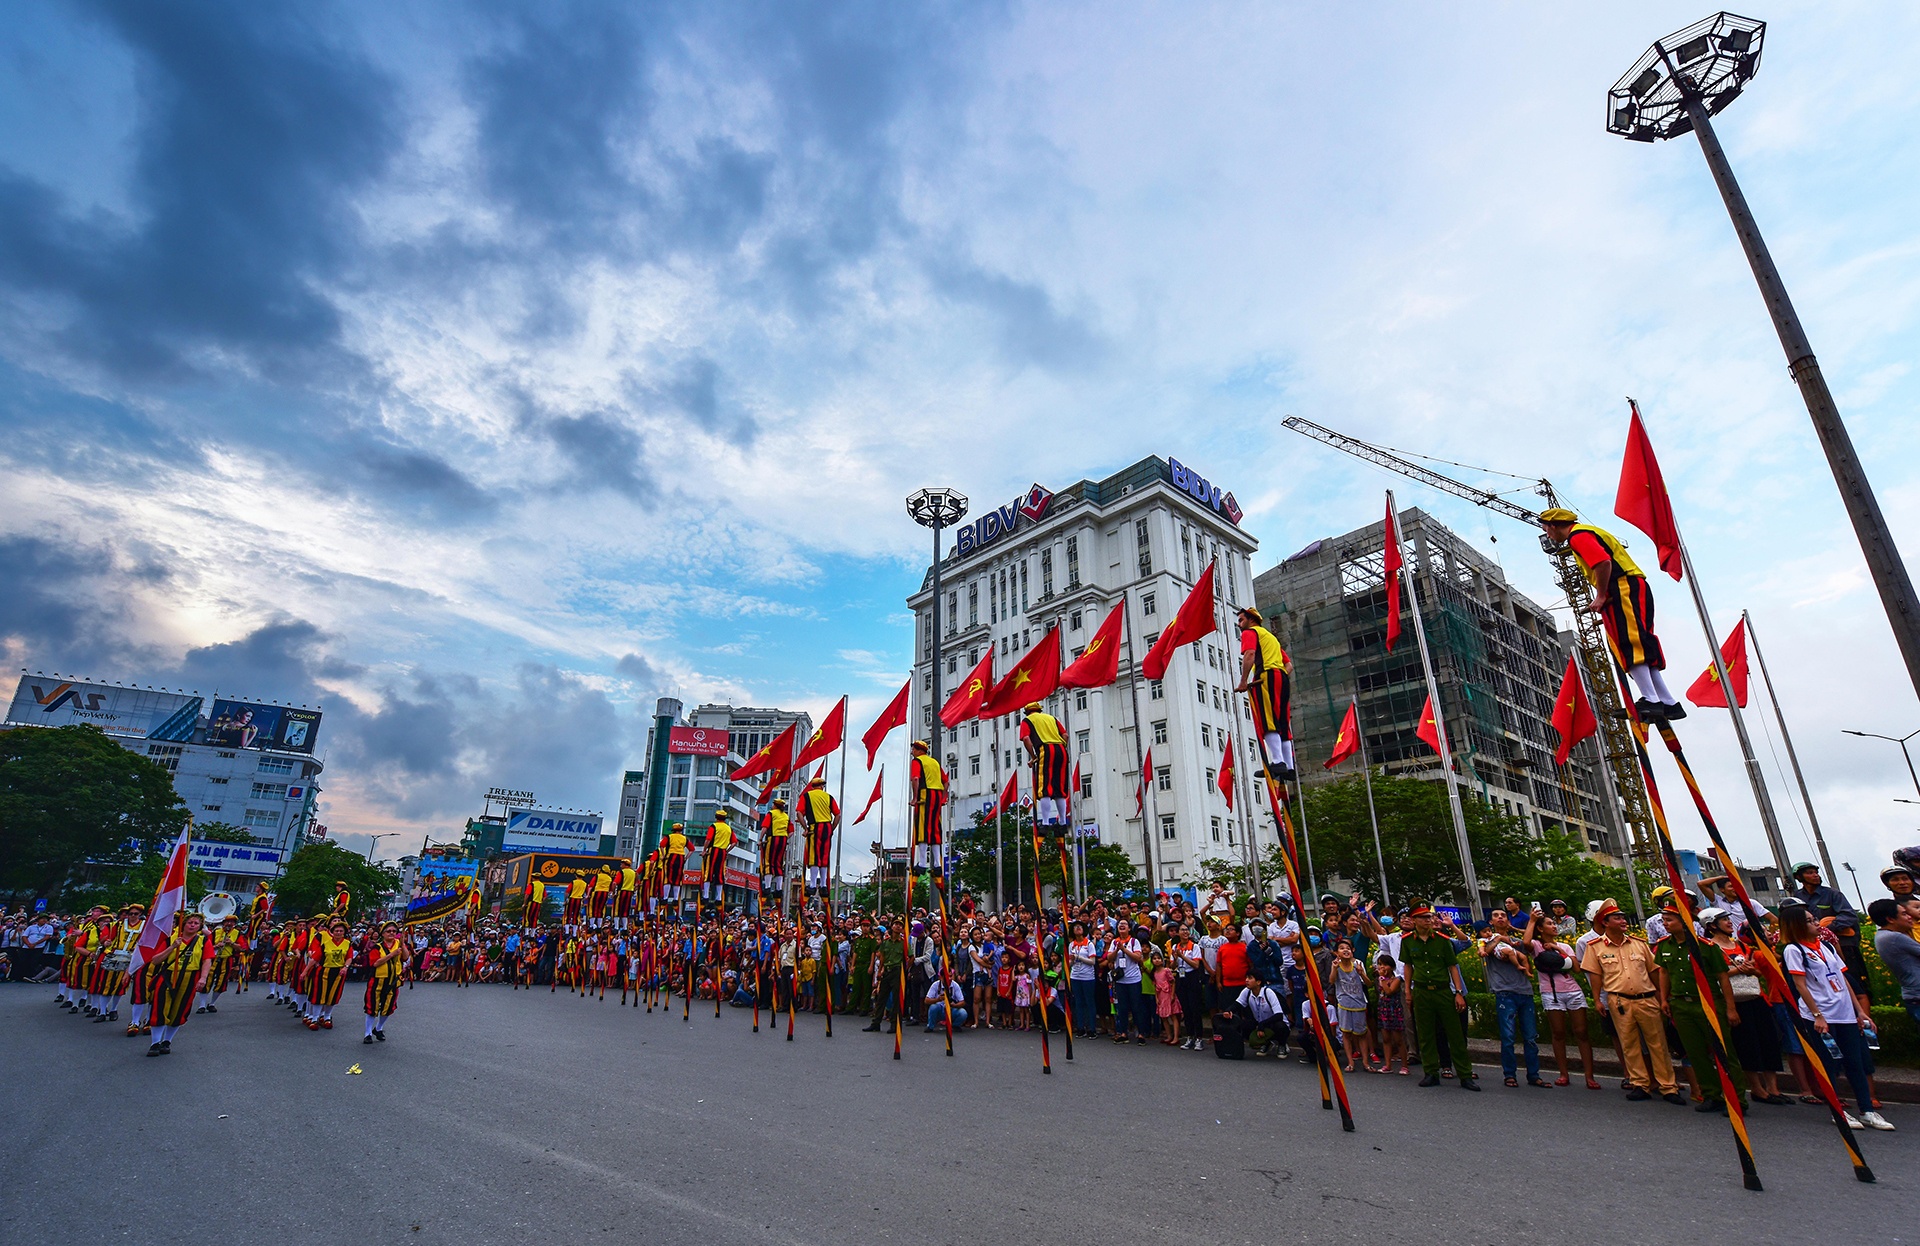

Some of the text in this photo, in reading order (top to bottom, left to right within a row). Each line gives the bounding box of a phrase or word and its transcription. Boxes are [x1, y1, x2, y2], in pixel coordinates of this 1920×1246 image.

[1169, 456, 1221, 512] BIDV
[957, 496, 1022, 556] BIDV
[31, 684, 106, 712] VAS
[672, 739, 725, 750] Hanwha Life
[526, 816, 598, 834] DAIKIN
